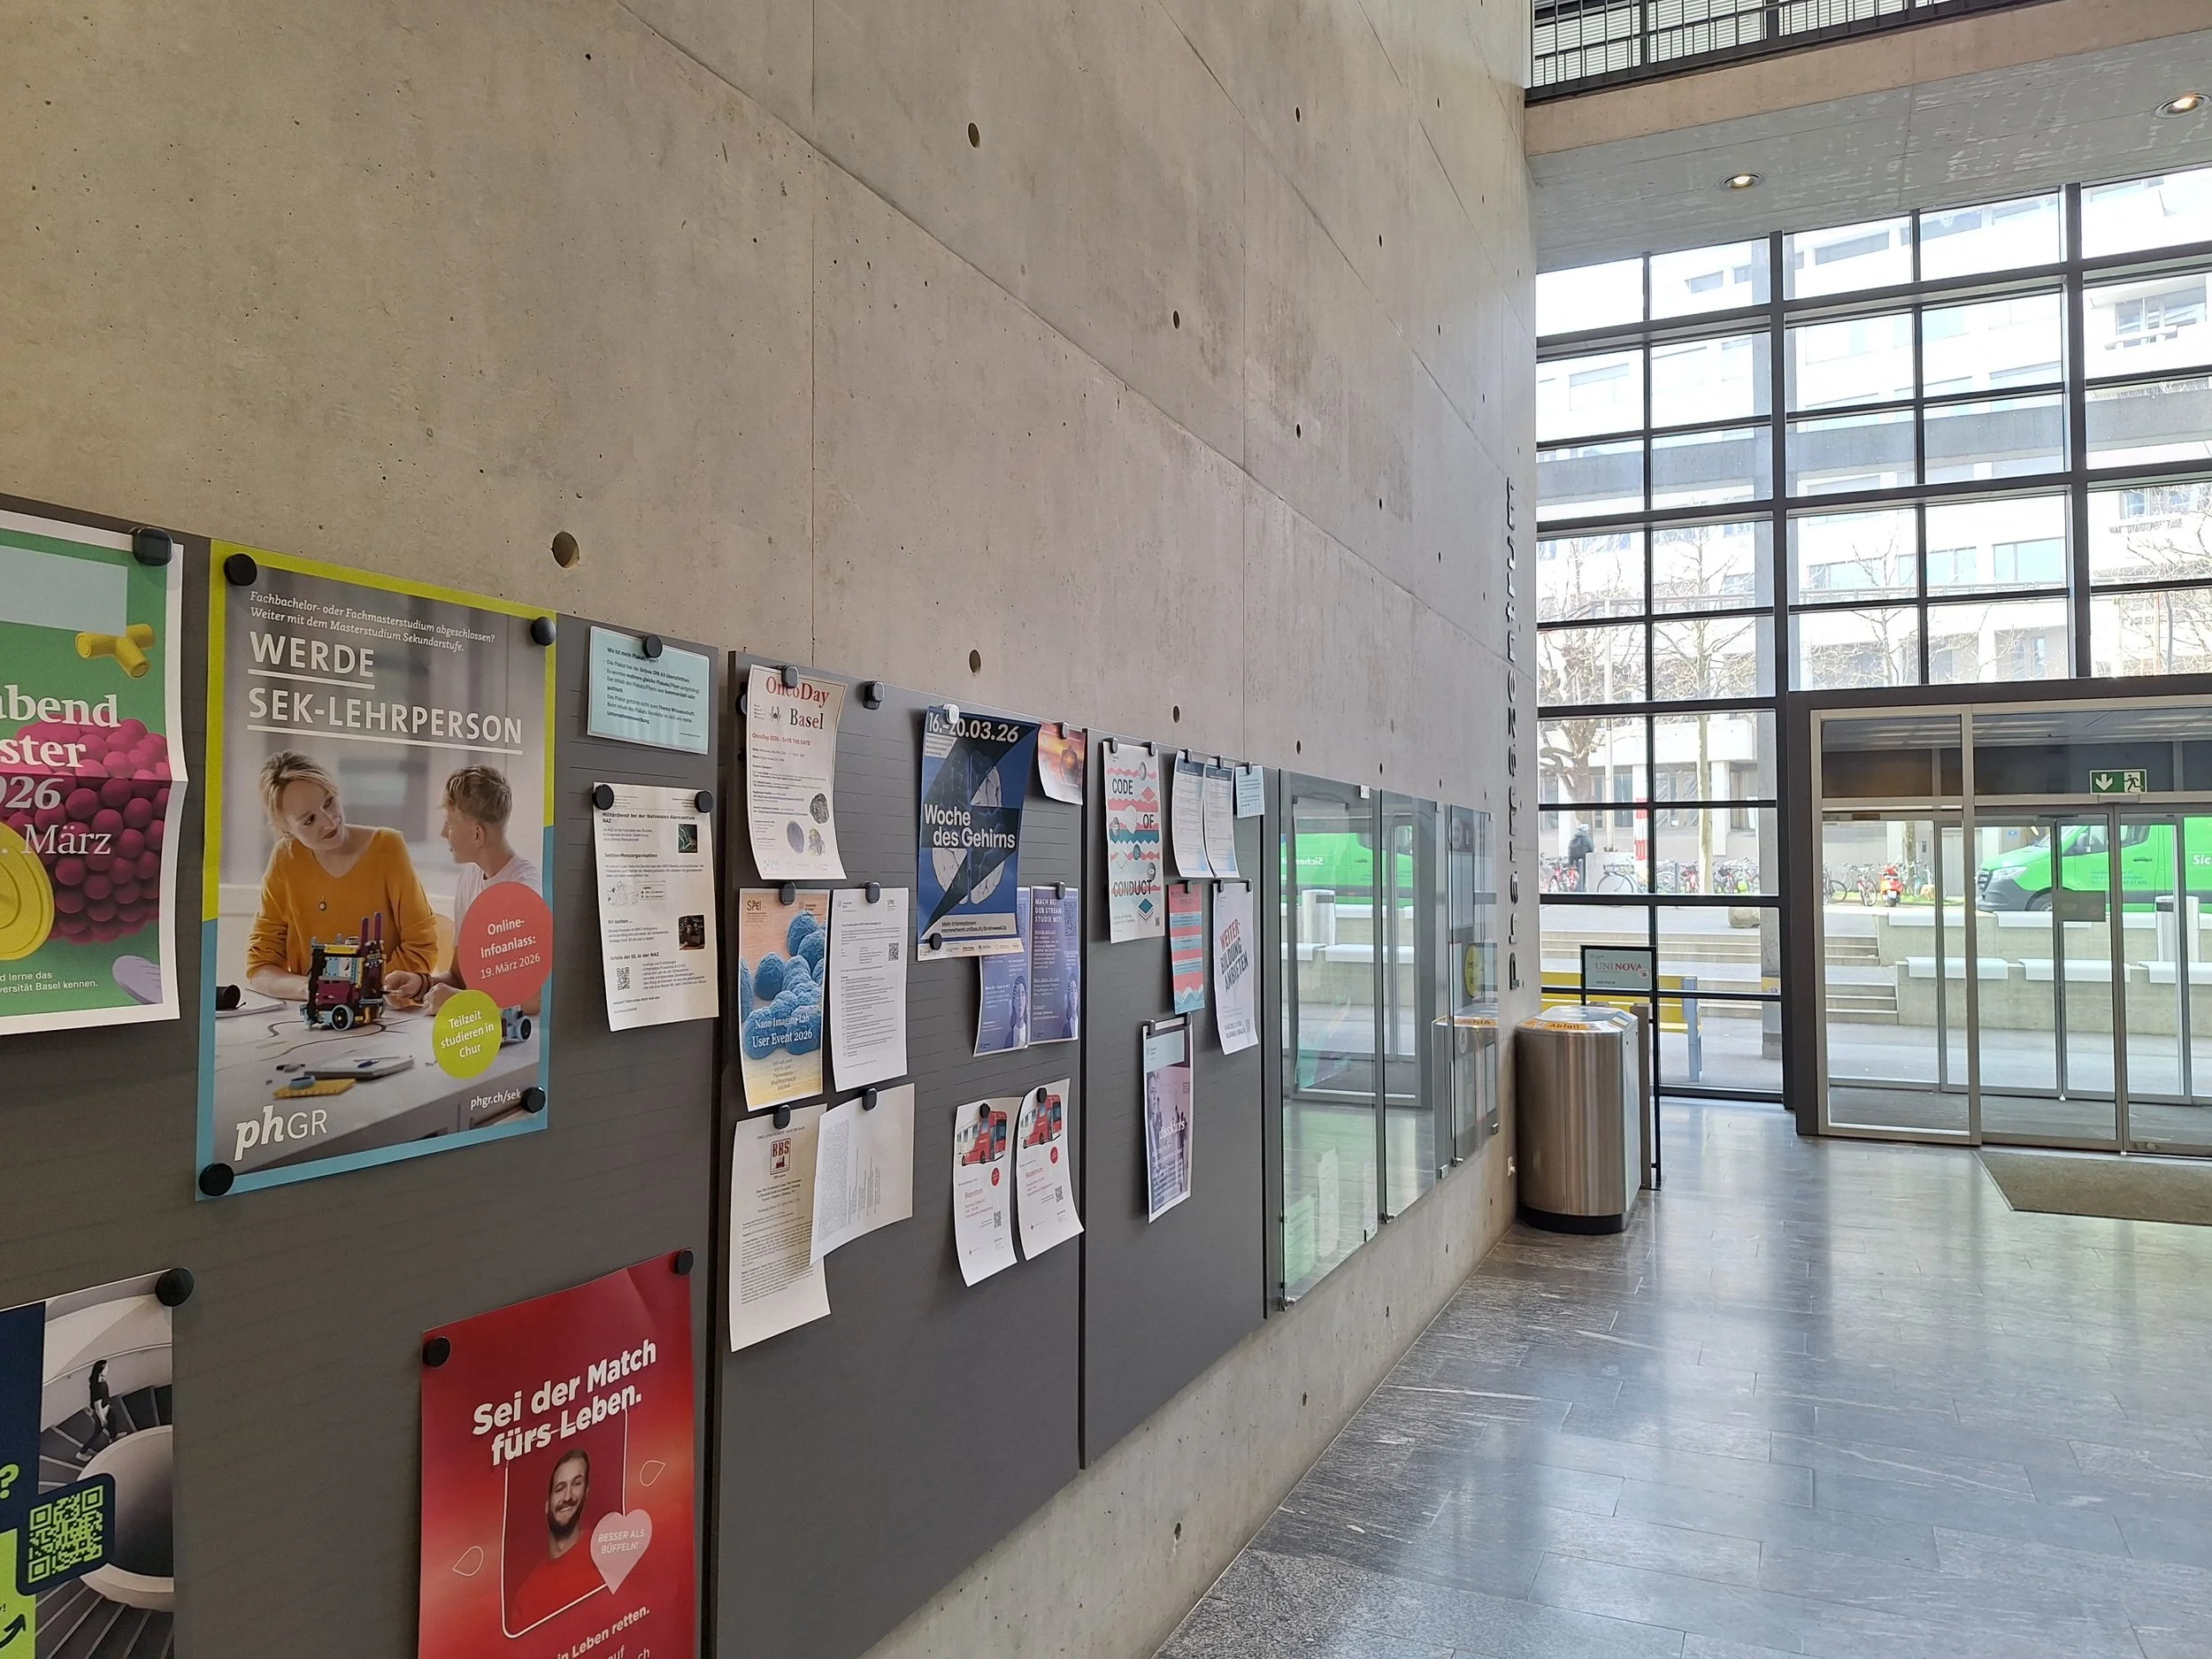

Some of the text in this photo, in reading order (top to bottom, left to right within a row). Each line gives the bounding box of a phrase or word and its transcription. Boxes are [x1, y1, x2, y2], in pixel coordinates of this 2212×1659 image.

[250, 590, 495, 644] Fachbachelor- oder Fachmasterstudium abgeschlossen?
[250, 607, 465, 652] Weiter mit dem Masterstudium Sekundarstufe.
[249, 632, 375, 678] WERDE
[248, 687, 523, 745] SEK-LEHRPERSON
[789, 708, 824, 729] Basel
[0, 776, 64, 810] 26
[1112, 780, 1133, 795] CODE
[925, 803, 971, 826] Woche
[1142, 814, 1154, 829] OF
[21, 824, 112, 855] März
[933, 826, 1016, 849] des Gehirns
[1113, 879, 1153, 896] CONDUCT
[487, 917, 526, 936] Online-
[480, 935, 536, 958] Infoanlass:
[1219, 937, 1242, 975] BILDUNG
[495, 959, 518, 977] März
[519, 953, 541, 968] 2026
[1225, 951, 1248, 993] ANBIETEN
[36, 981, 60, 991] Basel
[449, 1010, 482, 1029] Teilzeit
[755, 1013, 810, 1030] Nano Imaging Lab
[441, 1021, 495, 1049] studieren in
[752, 1028, 812, 1048] User Event 2026
[459, 1042, 481, 1058] Chur
[471, 1088, 521, 1110] phgr.ch/sek
[234, 1104, 327, 1161] phGR
[772, 1141, 789, 1157] BBS
[472, 1338, 657, 1436] Sei der Match
[491, 1384, 642, 1467] fürs Leben.
[598, 1528, 644, 1543] BESSER ALS
[601, 1540, 639, 1555] BÜFFELN!
[572, 1628, 609, 1658] Leben
[611, 1606, 650, 1635] retten.
